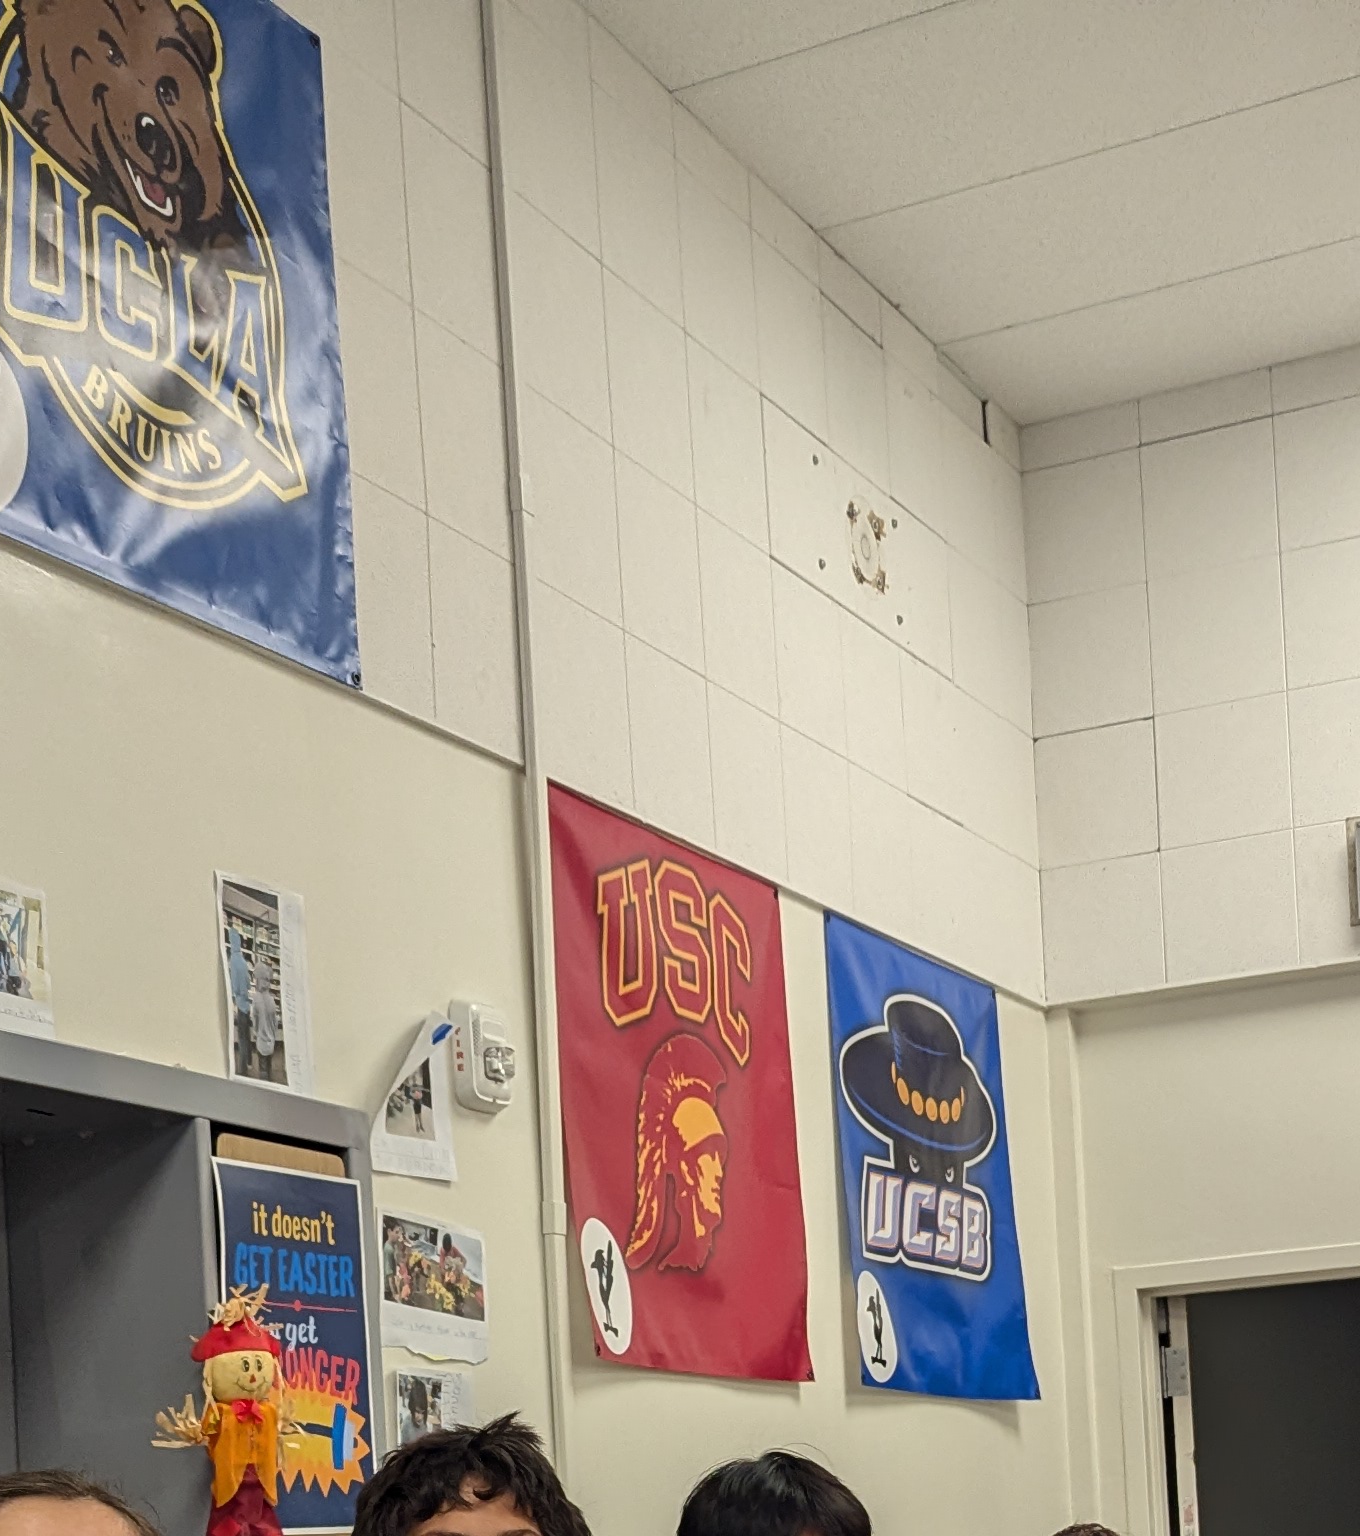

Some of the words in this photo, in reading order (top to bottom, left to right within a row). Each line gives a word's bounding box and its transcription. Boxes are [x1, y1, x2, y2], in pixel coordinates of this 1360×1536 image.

[82, 365, 222, 471] BRUINS
[597, 859, 751, 1066] USC
[252, 1201, 268, 1235] it
[271, 1204, 335, 1246] doesn't
[867, 1170, 987, 1270] UCSB
[233, 1241, 273, 1289] GET
[278, 1248, 356, 1298] EASIER
[285, 1315, 318, 1351] get
[278, 1346, 360, 1406] ONGER
